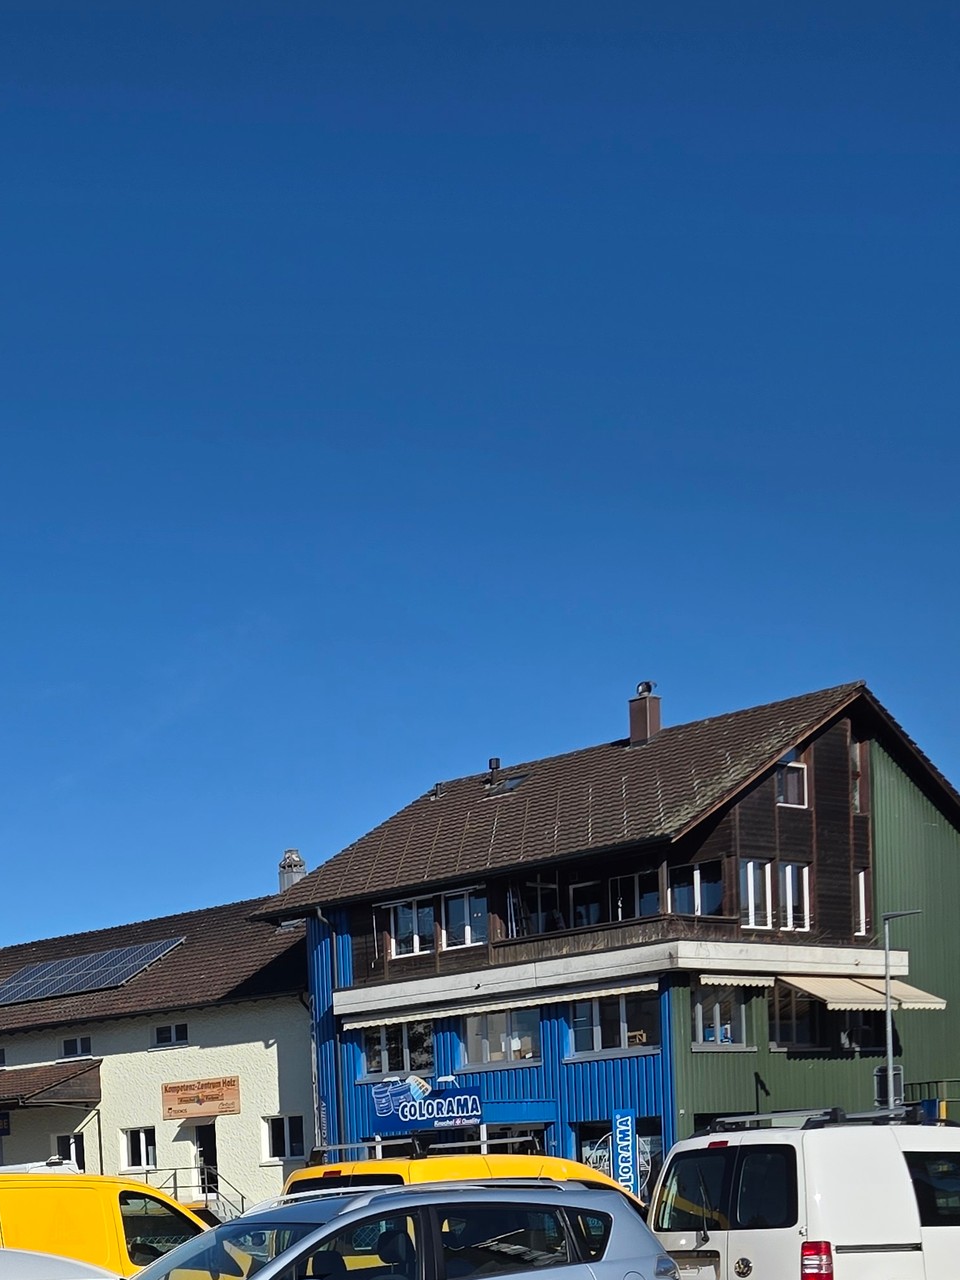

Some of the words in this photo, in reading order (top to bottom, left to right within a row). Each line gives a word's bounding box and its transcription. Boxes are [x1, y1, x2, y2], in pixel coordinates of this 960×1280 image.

[164, 1081, 221, 1094] Kompetenz-Zentrum
[222, 1078, 236, 1087] Holz
[398, 1095, 481, 1121] COLORAMA
[617, 1116, 634, 1193] OLORAMA
